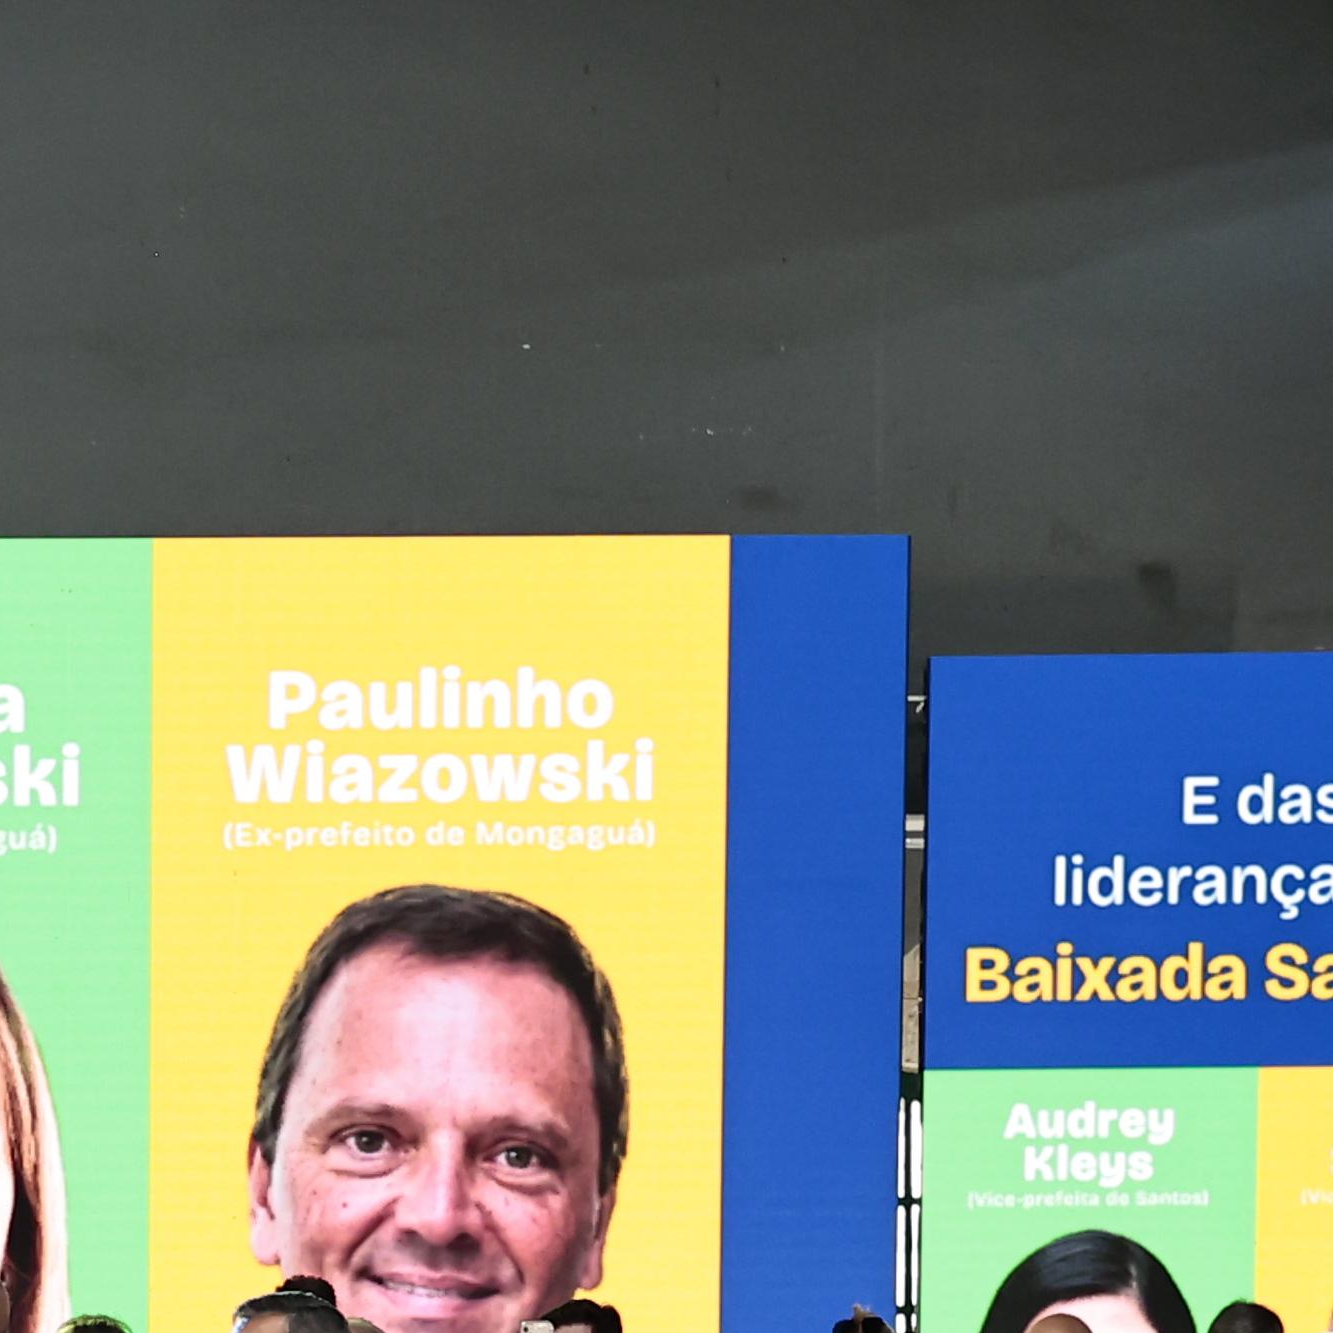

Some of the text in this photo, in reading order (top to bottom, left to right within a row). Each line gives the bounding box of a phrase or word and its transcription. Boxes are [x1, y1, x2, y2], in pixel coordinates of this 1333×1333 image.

[269, 664, 614, 731] Paulinho
[226, 738, 655, 804] Wiazowski
[1183, 776, 1220, 825] E
[223, 819, 656, 852] (Ex-prefeito de Mongaguá)
[965, 942, 1247, 1003] Baixada
[1003, 1101, 1176, 1145] Audrey
[1023, 1144, 1155, 1188] Kleys
